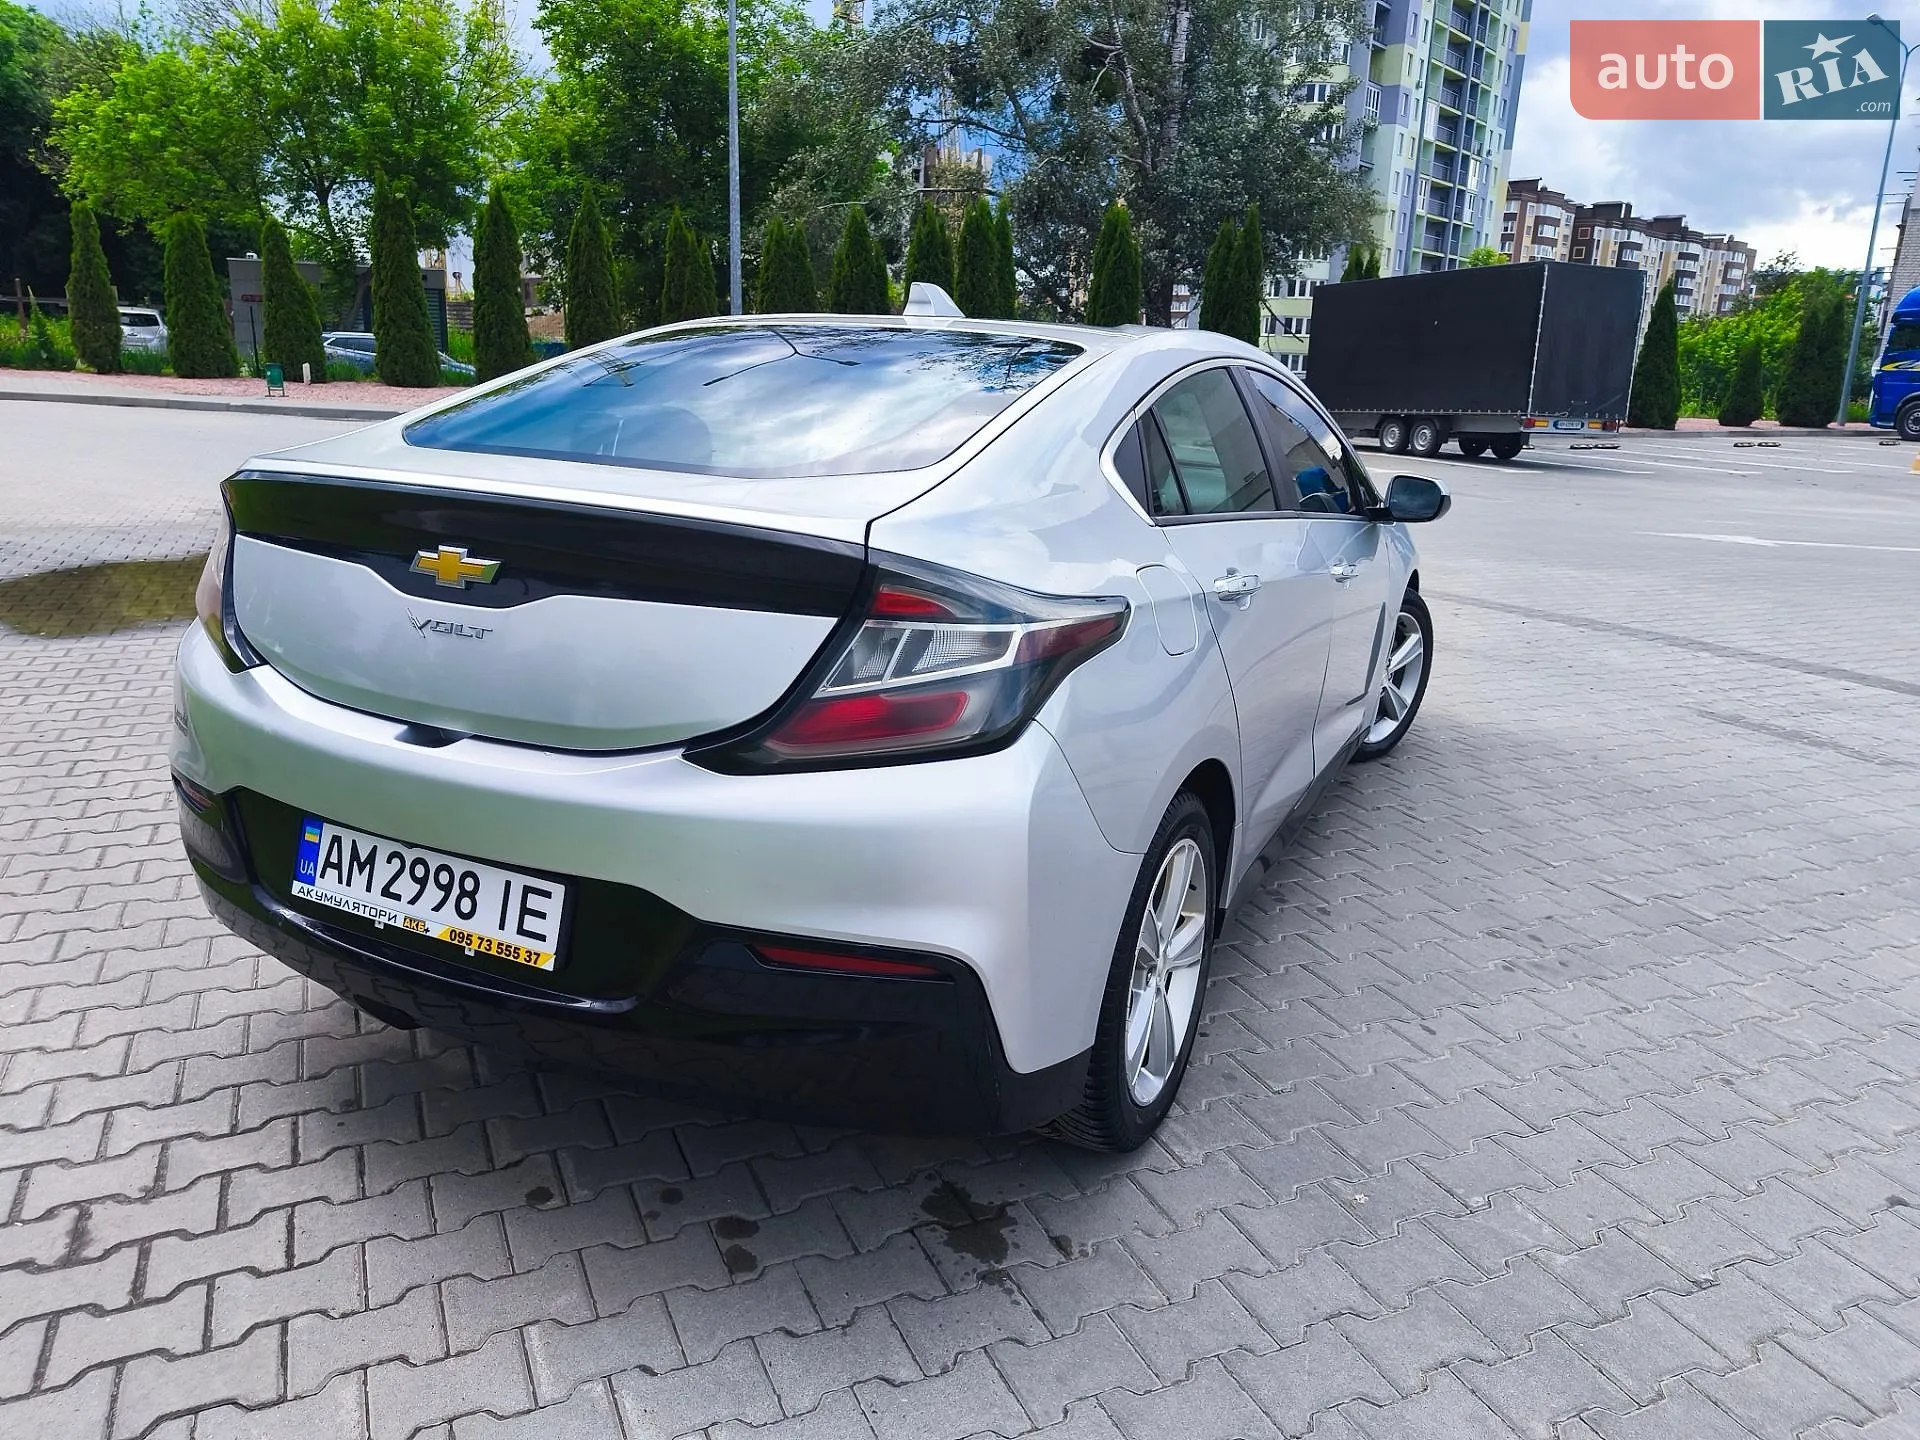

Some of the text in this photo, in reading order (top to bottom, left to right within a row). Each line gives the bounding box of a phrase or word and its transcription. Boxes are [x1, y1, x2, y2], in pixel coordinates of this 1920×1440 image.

[406, 607, 493, 639] VOLT
[299, 858, 316, 878] UA
[319, 834, 553, 943] AM 2998 IE
[297, 884, 398, 924] АКУМУЛЯТОРИ
[449, 928, 474, 948] 095
[477, 937, 493, 952] 73
[495, 942, 521, 960] 555
[523, 951, 541, 966] 37
